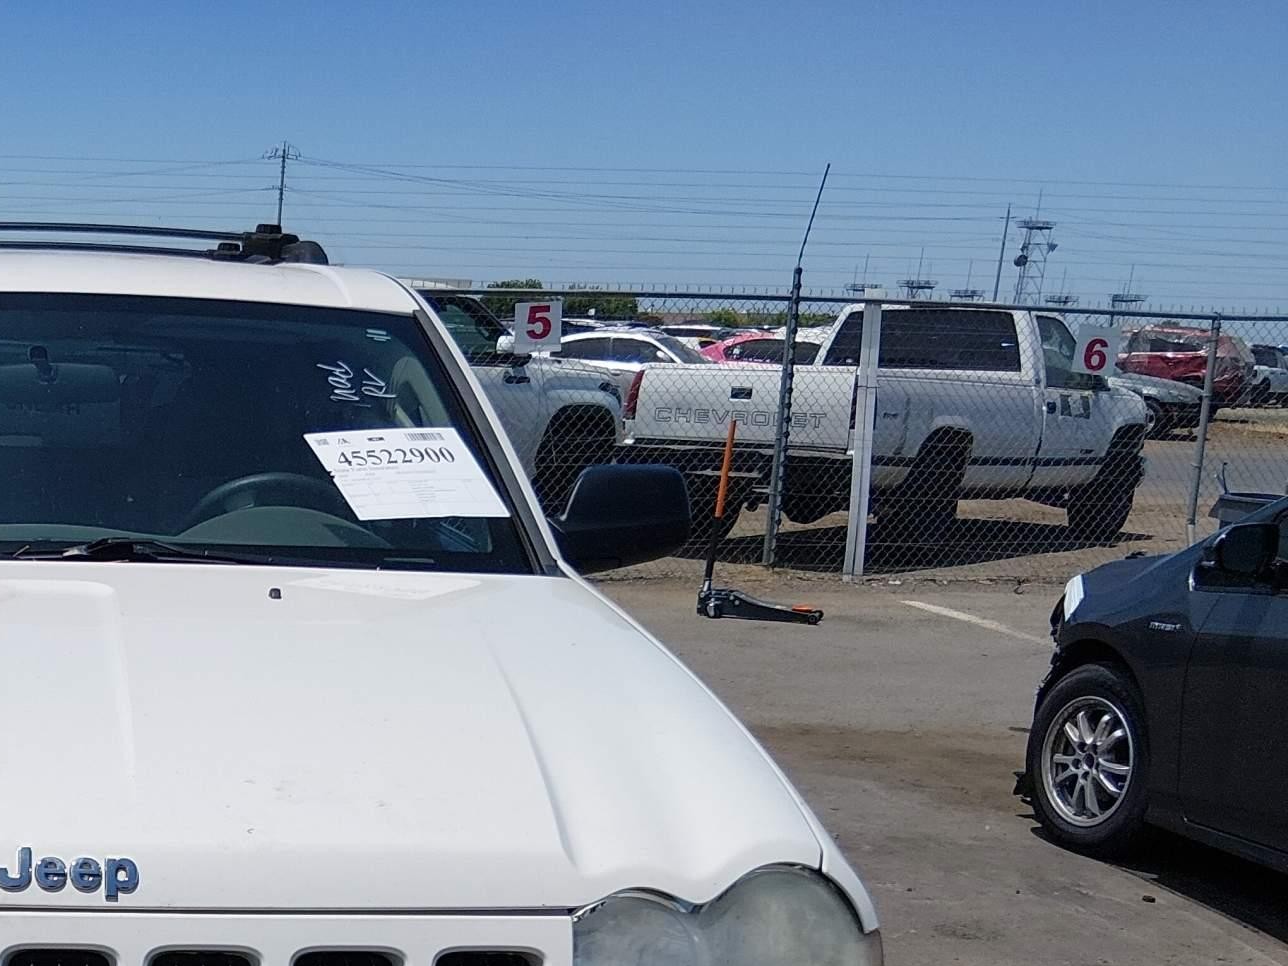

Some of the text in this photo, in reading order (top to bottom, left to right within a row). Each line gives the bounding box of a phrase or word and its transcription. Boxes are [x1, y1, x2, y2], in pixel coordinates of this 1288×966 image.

[526, 304, 552, 340] 5
[1084, 338, 1109, 372] 6
[654, 407, 827, 429] CHEVROET
[337, 446, 455, 467] 45522900
